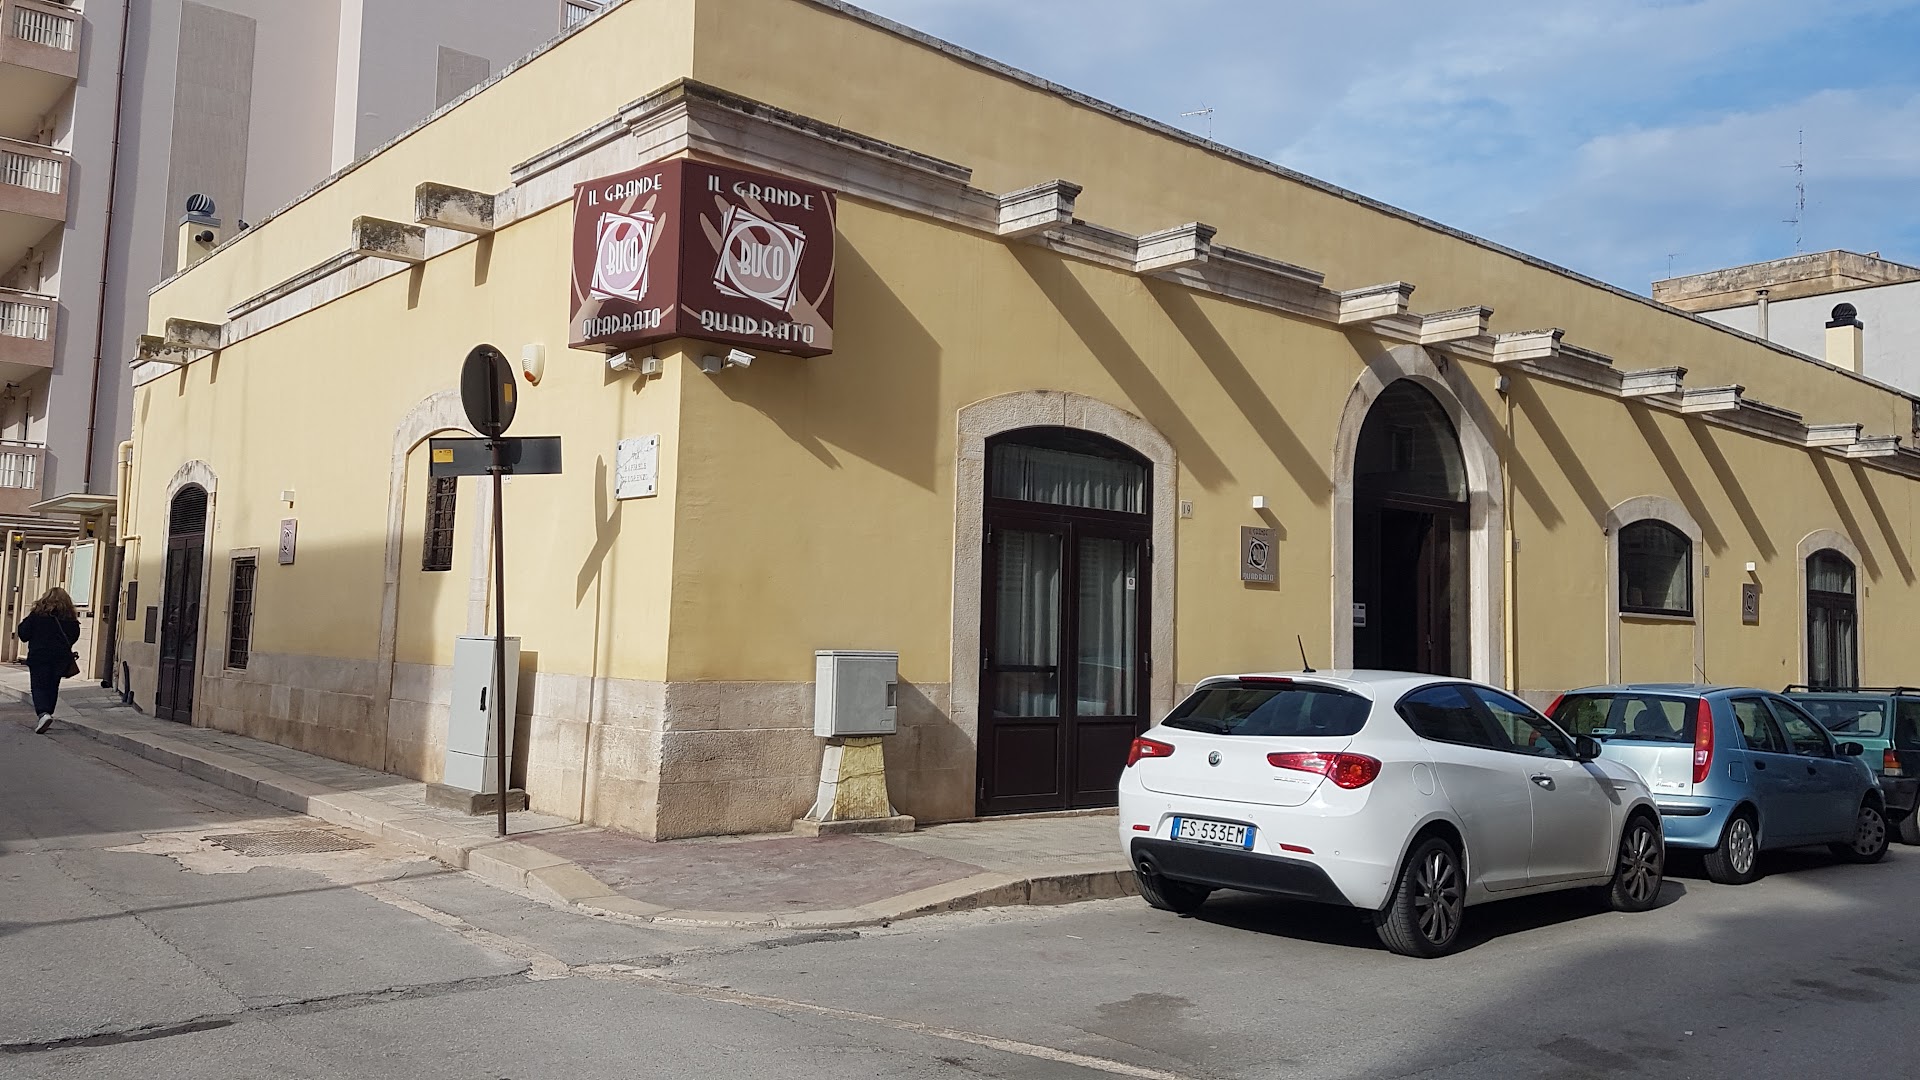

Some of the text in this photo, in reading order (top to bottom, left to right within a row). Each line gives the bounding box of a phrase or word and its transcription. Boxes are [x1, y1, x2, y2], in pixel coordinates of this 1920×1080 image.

[588, 173, 663, 206] IL GRANDE
[708, 175, 815, 211] IL GRANDE
[606, 236, 639, 276] BUCO
[737, 240, 784, 281] BUCO
[582, 308, 661, 339] QUADRATO
[701, 309, 815, 344] QUADRATO
[1183, 504, 1191, 514] 19
